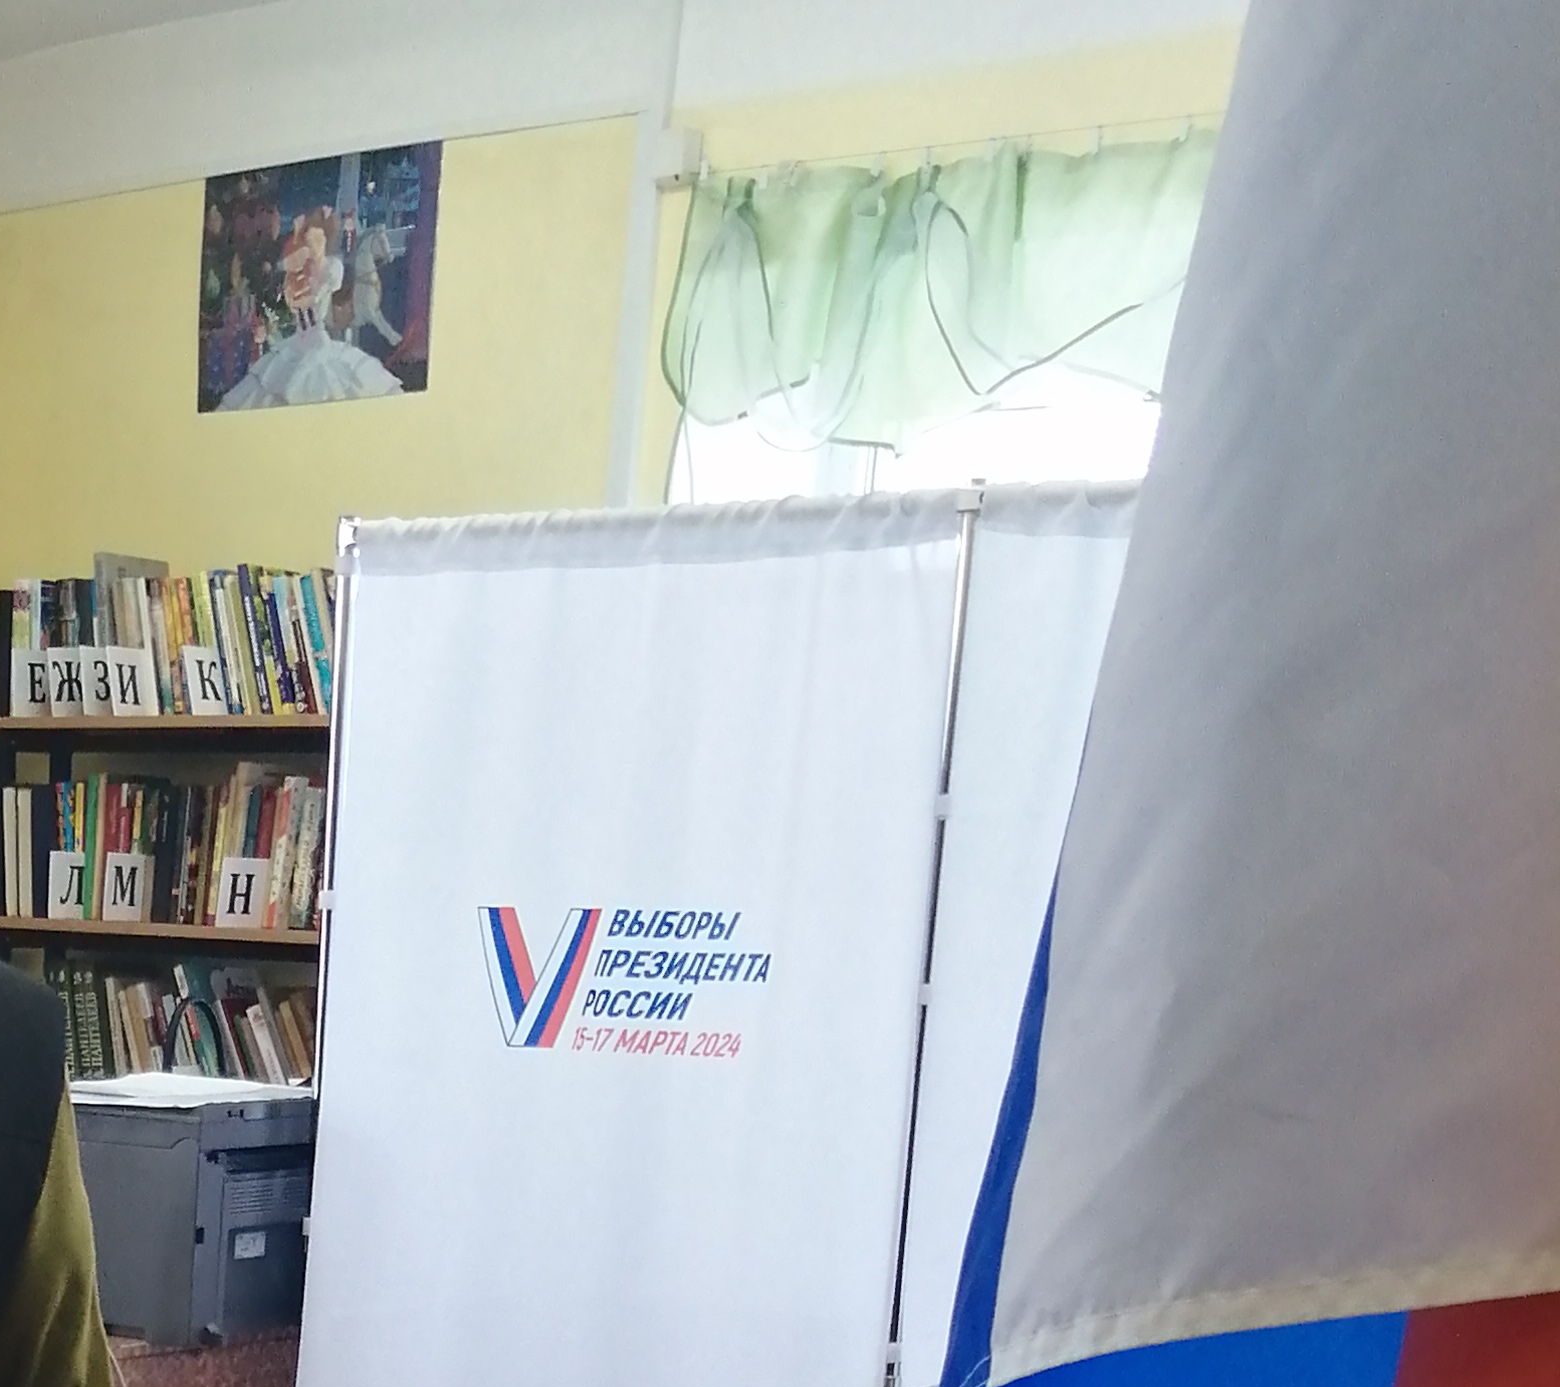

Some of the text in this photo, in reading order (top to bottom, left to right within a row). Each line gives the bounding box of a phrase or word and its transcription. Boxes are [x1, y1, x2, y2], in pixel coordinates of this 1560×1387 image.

[52, 660, 83, 702] Ж
[94, 660, 110, 701] З
[116, 664, 140, 706] И
[195, 658, 223, 702] К
[60, 865, 85, 906] Л
[112, 866, 139, 907] М
[606, 907, 742, 941] ВЫБОРЫ
[594, 949, 772, 985] ПРЕЗИДЕНТА
[581, 989, 693, 1021] РОССИИ
[571, 1027, 742, 1058] 15-17 МАРТА 2024
